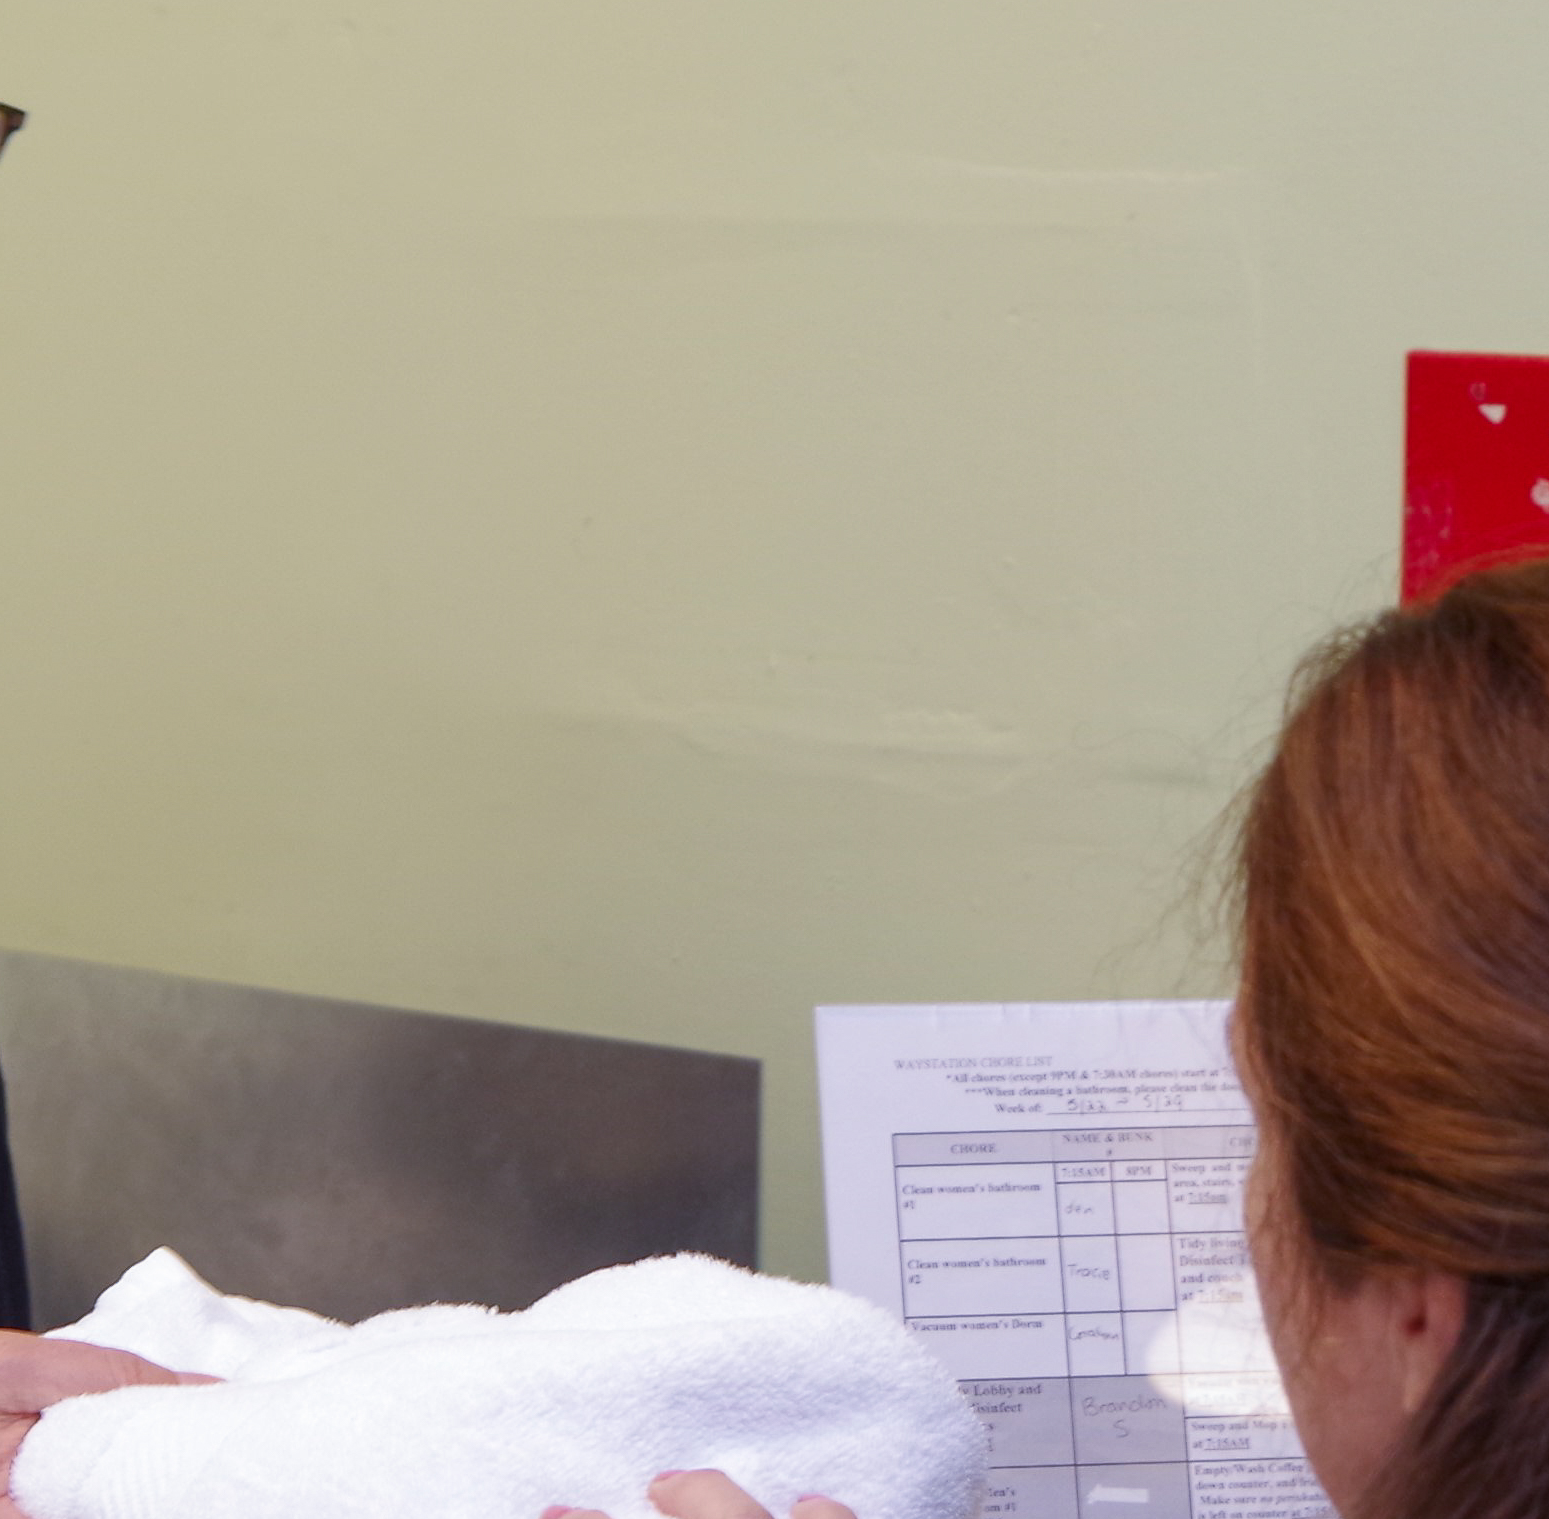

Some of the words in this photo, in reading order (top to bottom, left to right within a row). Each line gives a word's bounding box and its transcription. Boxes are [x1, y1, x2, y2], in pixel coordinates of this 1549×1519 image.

[980, 1056, 1022, 1068] CHORE
[1026, 1055, 1053, 1067] LIST
[994, 1103, 1025, 1113] Week
[1062, 1132, 1099, 1144] NAME
[1104, 1132, 1113, 1143] &
[1117, 1132, 1154, 1143] BUNK
[950, 1142, 997, 1154] CHORE
[1212, 1163, 1231, 1172] and
[902, 1184, 933, 1195] Clean
[937, 1183, 985, 1193] women's
[988, 1181, 1041, 1192] bathroom
[1179, 1237, 1205, 1251] Tidy
[907, 1259, 939, 1270] Clean
[942, 1258, 990, 1269] women's
[993, 1257, 1046, 1267] bathroom
[1181, 1273, 1203, 1283] and
[912, 1321, 956, 1331] Vacuum
[960, 1319, 1008, 1330] women's
[1012, 1319, 1043, 1329] Dorm
[974, 1385, 1013, 1398] Lobby
[1018, 1384, 1042, 1394] and
[1113, 1419, 1129, 1438] S
[1191, 1421, 1226, 1432] Sweep
[1228, 1420, 1249, 1430] and
[1192, 1439, 1203, 1449] at
[1195, 1480, 1225, 1490] down
[1200, 1495, 1231, 1505] Make
[1234, 1495, 1257, 1504] sure
[1210, 1510, 1227, 1519] left
[1230, 1511, 1243, 1519] on
[1247, 1509, 1288, 1519] counter
